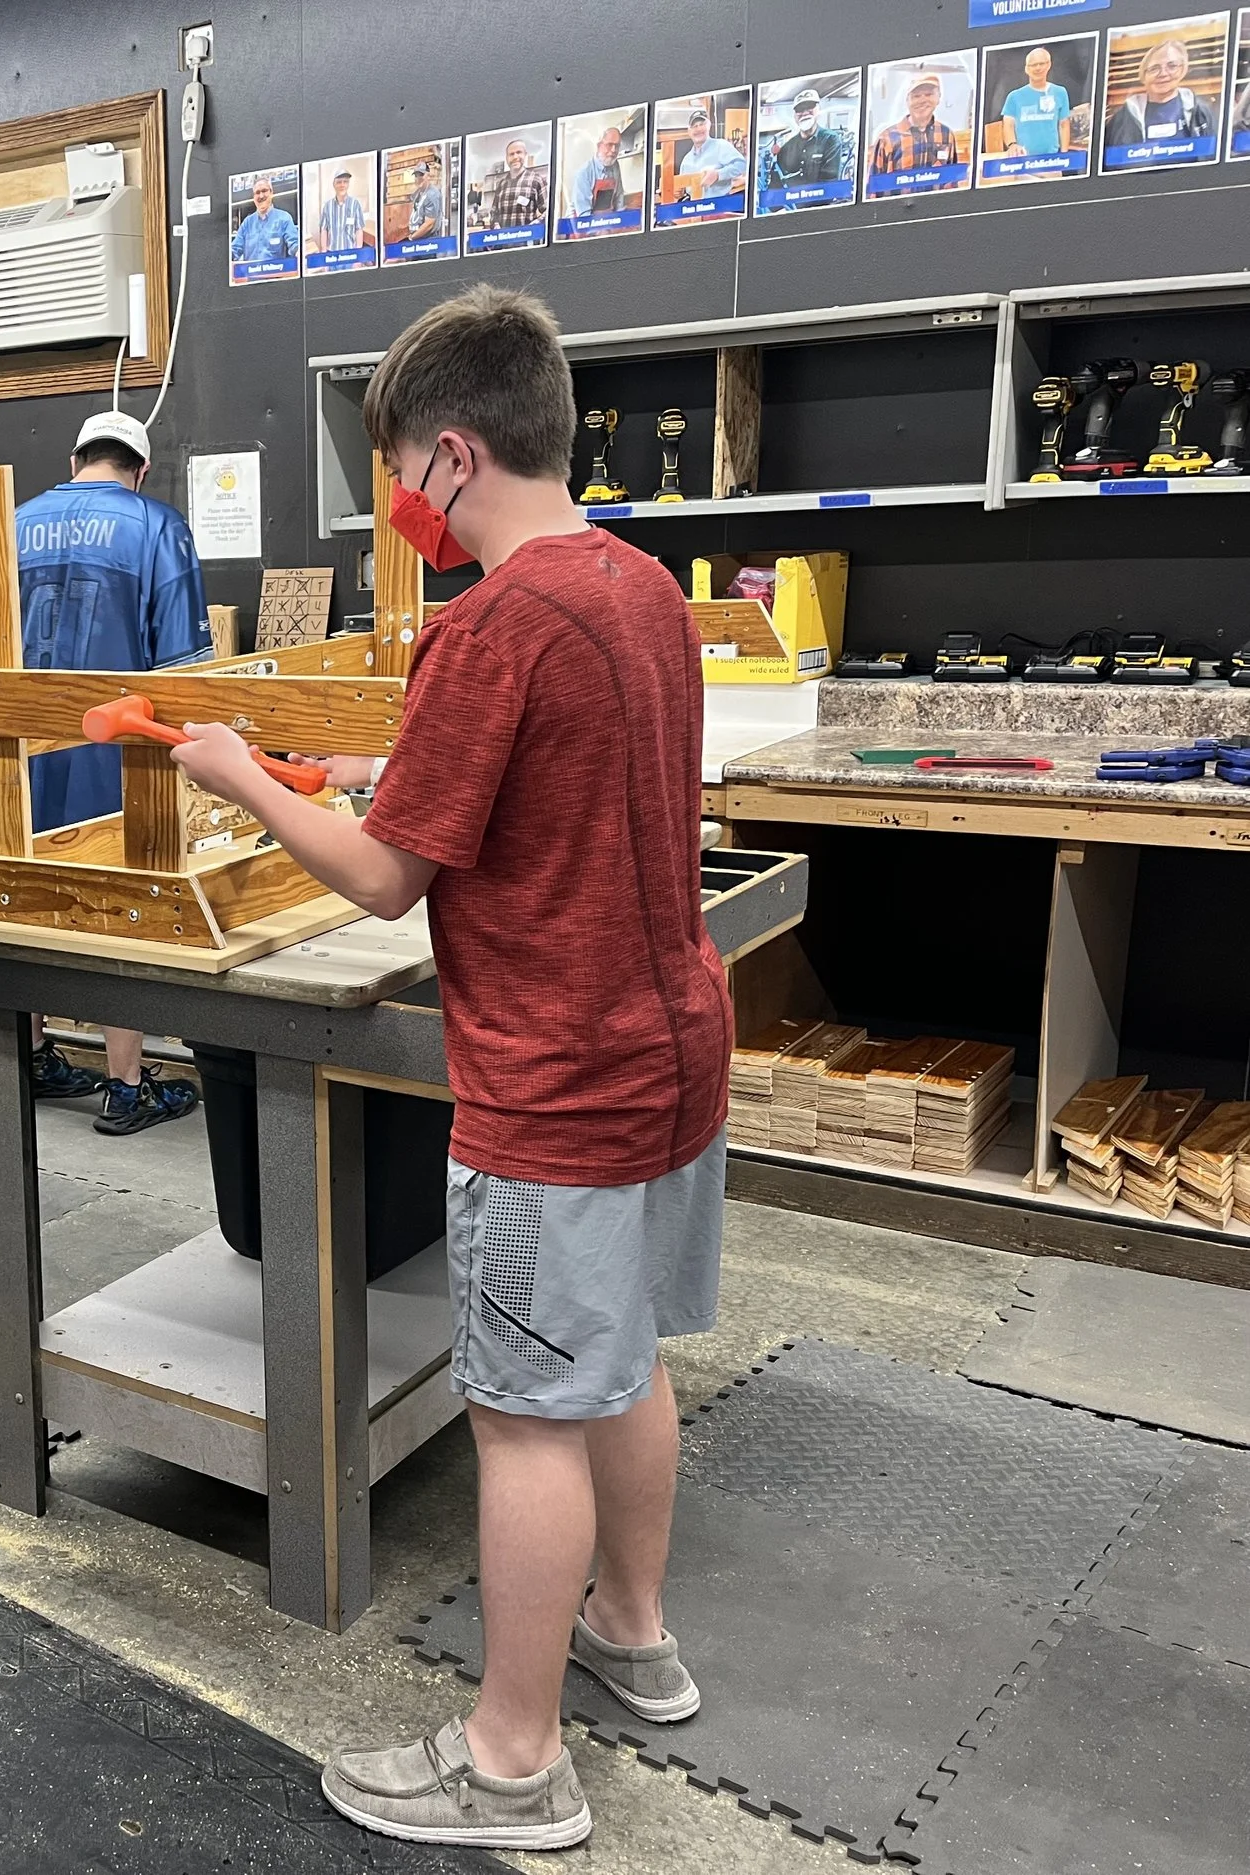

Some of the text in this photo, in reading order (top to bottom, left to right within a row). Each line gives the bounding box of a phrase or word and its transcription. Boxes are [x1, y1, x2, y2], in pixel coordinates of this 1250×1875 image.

[992, 0, 1087, 16] VOLUNTEER LEAD
[20, 519, 115, 554] JOHNSON
[720, 656, 748, 667] subject
[749, 656, 790, 664] notebooks
[749, 666, 790, 674] wide ruled
[856, 809, 885, 818] FRONT
